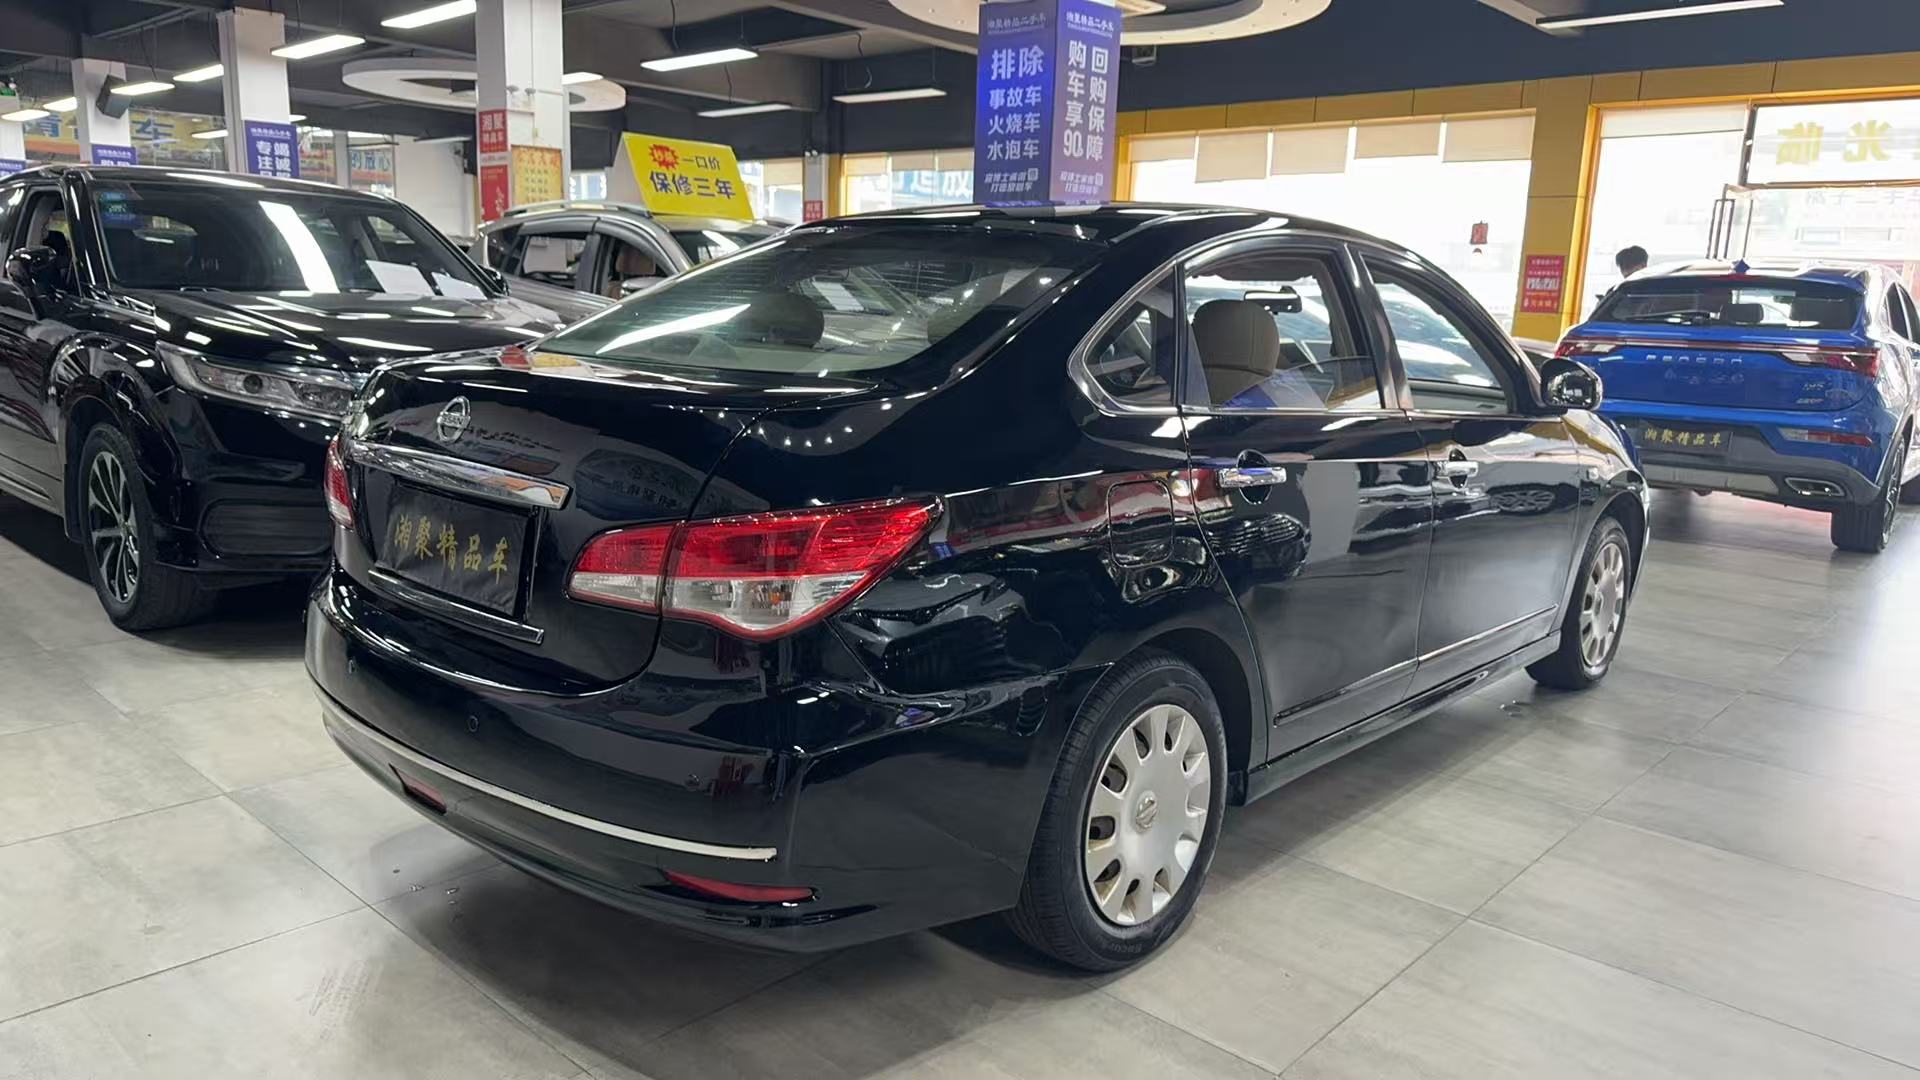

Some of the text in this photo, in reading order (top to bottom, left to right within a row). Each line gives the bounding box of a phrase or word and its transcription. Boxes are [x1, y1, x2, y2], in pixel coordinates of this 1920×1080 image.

[991, 45, 1044, 80] 排除
[989, 85, 1042, 110] 事故车
[1086, 46, 1109, 161] 回购保障
[988, 112, 1041, 135] 火烧车
[987, 139, 1040, 160] 水泡车
[682, 155, 721, 171] 一口价
[649, 170, 736, 200] 保修三年
[1645, 427, 1722, 448] 湘聚精品车
[394, 514, 508, 585] 湘聚精品车
